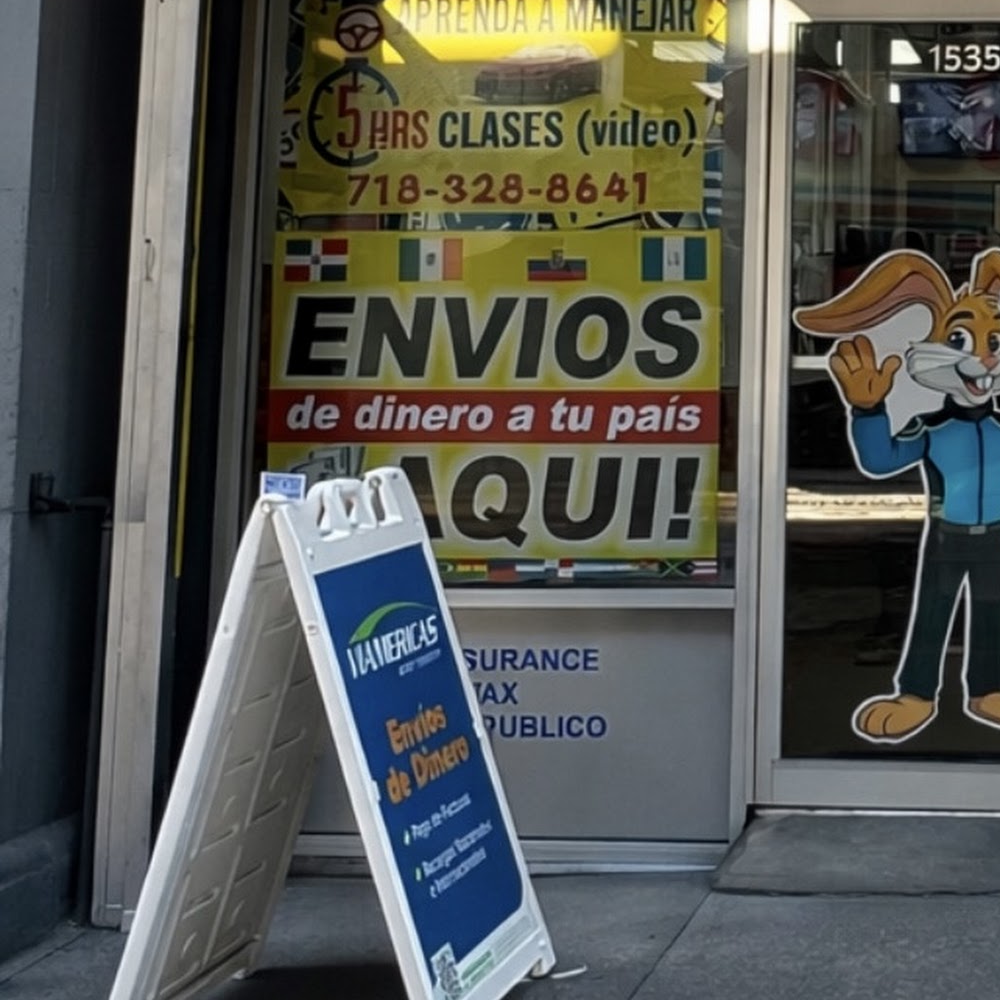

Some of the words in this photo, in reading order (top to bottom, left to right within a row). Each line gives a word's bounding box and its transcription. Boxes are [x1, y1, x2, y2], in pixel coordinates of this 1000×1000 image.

[337, 84, 362, 150] 5
[369, 110, 430, 150] HRS
[438, 110, 564, 150] CLASES
[577, 107, 697, 157] (video)
[347, 172, 649, 206] 718-328-8641
[285, 295, 703, 380] ENVIOS
[287, 395, 341, 431] de
[353, 395, 494, 432] dinero
[507, 402, 535, 432] a
[550, 397, 593, 432] tu
[606, 396, 702, 441] país
[463, 648, 600, 672] SURANCE
